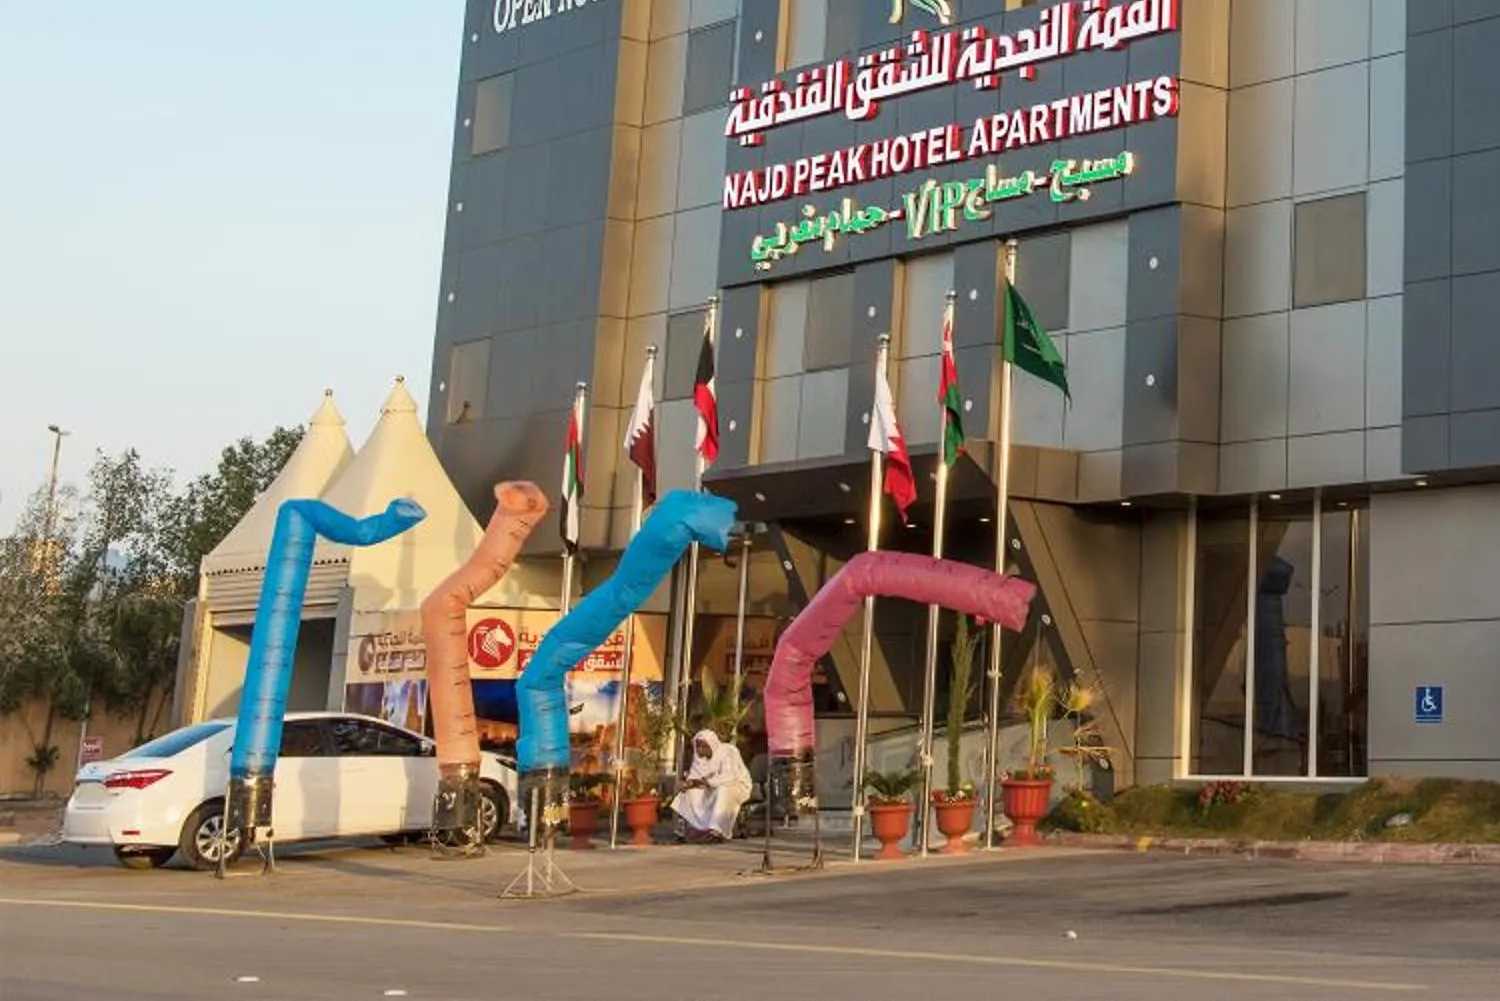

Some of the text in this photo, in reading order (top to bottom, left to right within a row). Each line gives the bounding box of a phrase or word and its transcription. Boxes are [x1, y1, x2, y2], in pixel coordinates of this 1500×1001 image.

[845, 29, 959, 120] للشقق
[954, 1, 1075, 89] النجدية
[723, 75, 1181, 210] NAJD PEAK HOTEL APARTMENTS
[724, 58, 849, 146] الفندقية
[902, 178, 967, 240] VIP
